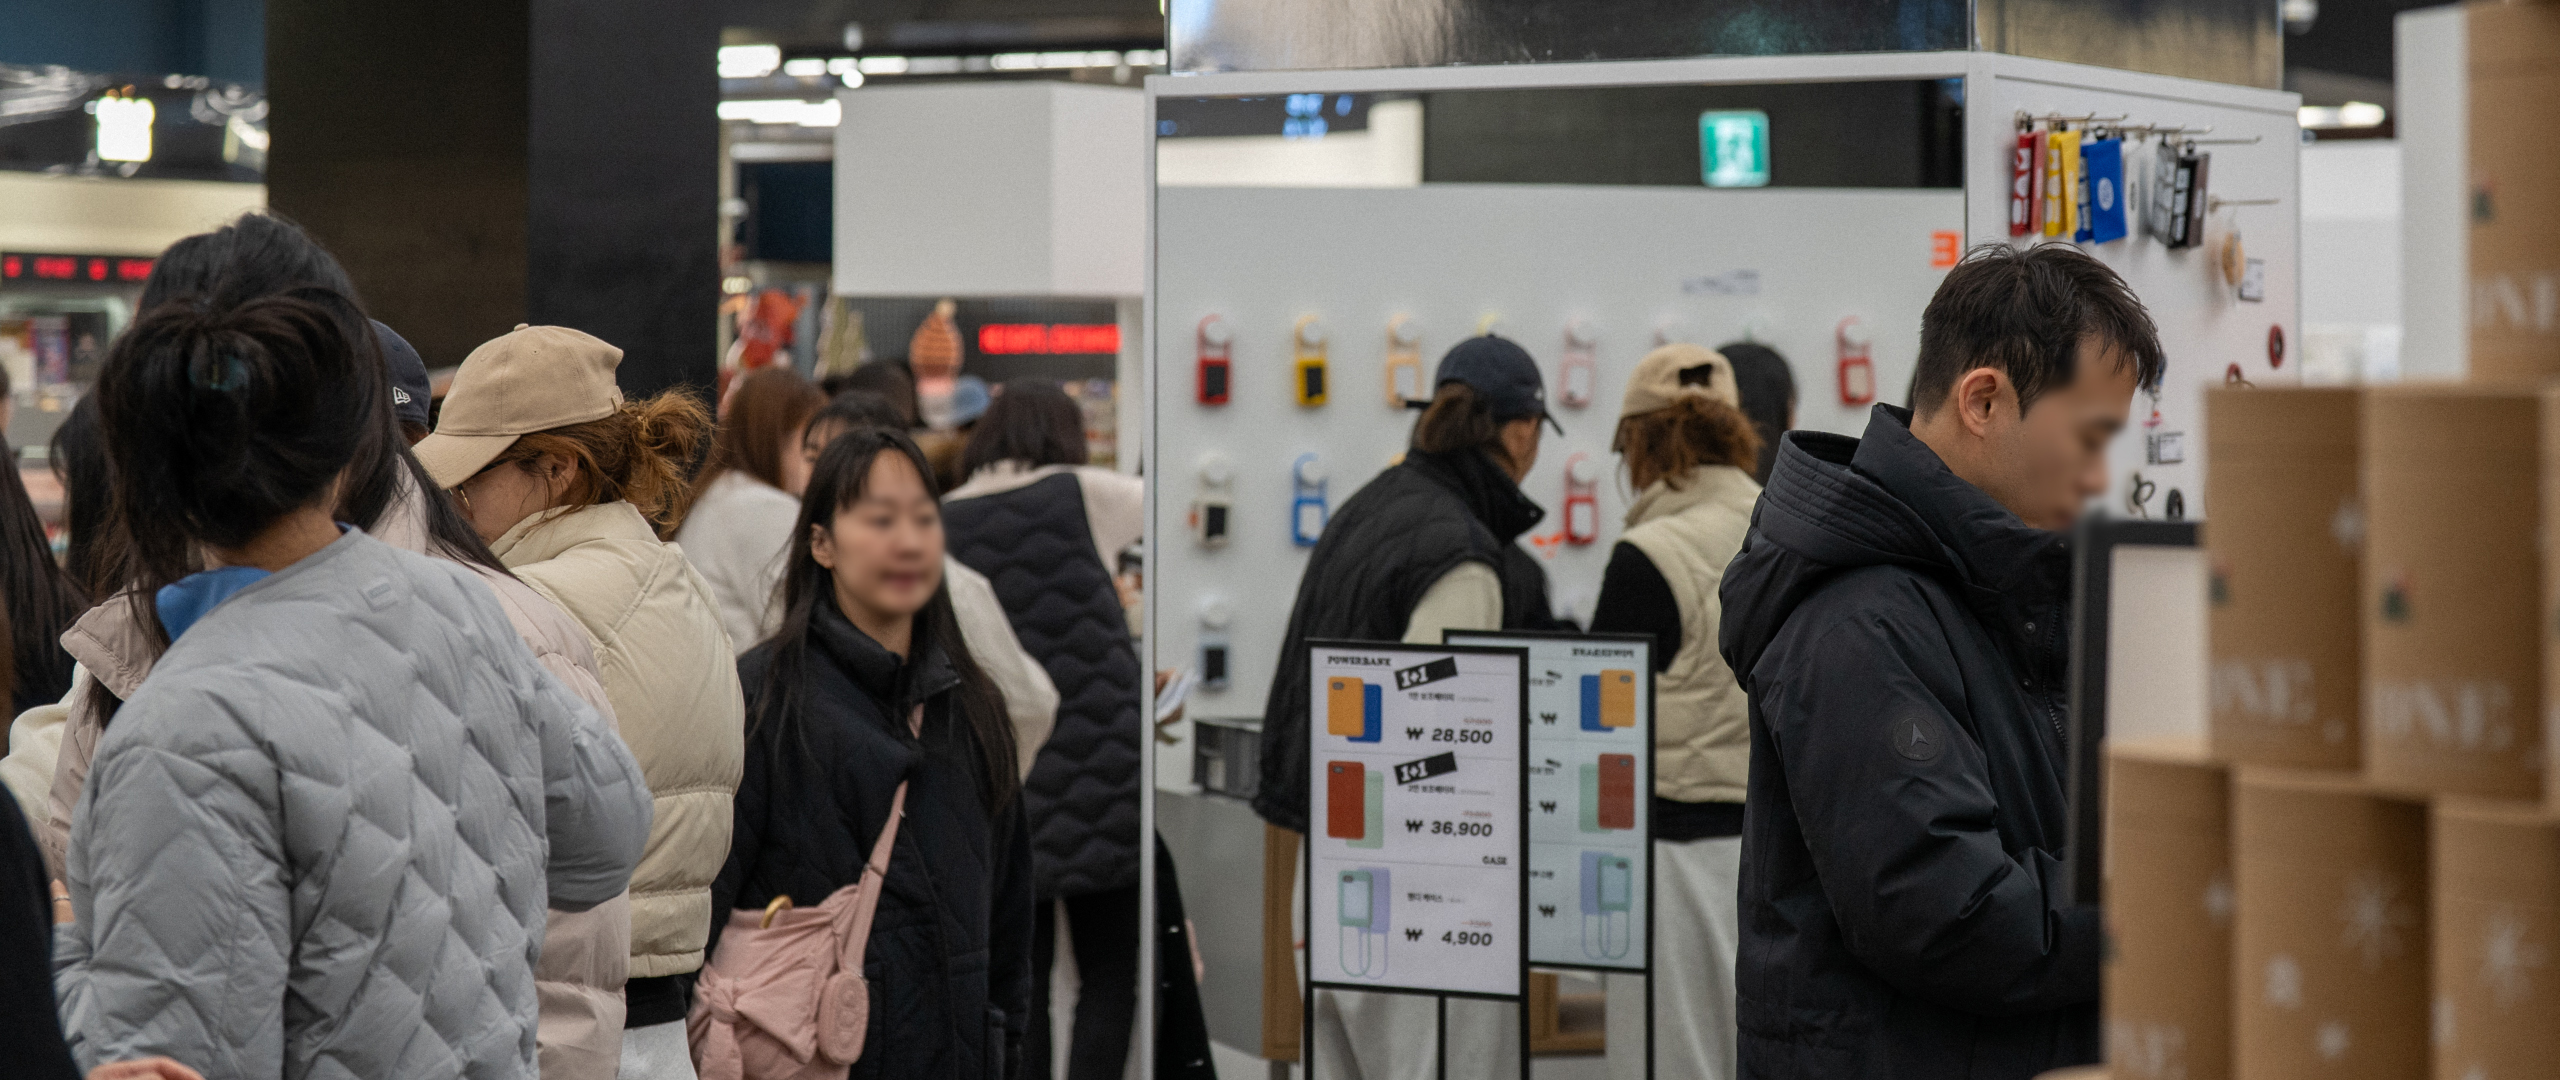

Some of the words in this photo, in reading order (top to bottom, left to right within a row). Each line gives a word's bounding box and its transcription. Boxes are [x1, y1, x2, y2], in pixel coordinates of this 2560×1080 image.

[1327, 655, 1391, 666] POWERBANK
[1432, 728, 1493, 744] 28,500
[1431, 820, 1493, 837] 36,900
[1441, 930, 1493, 946] 4,900
